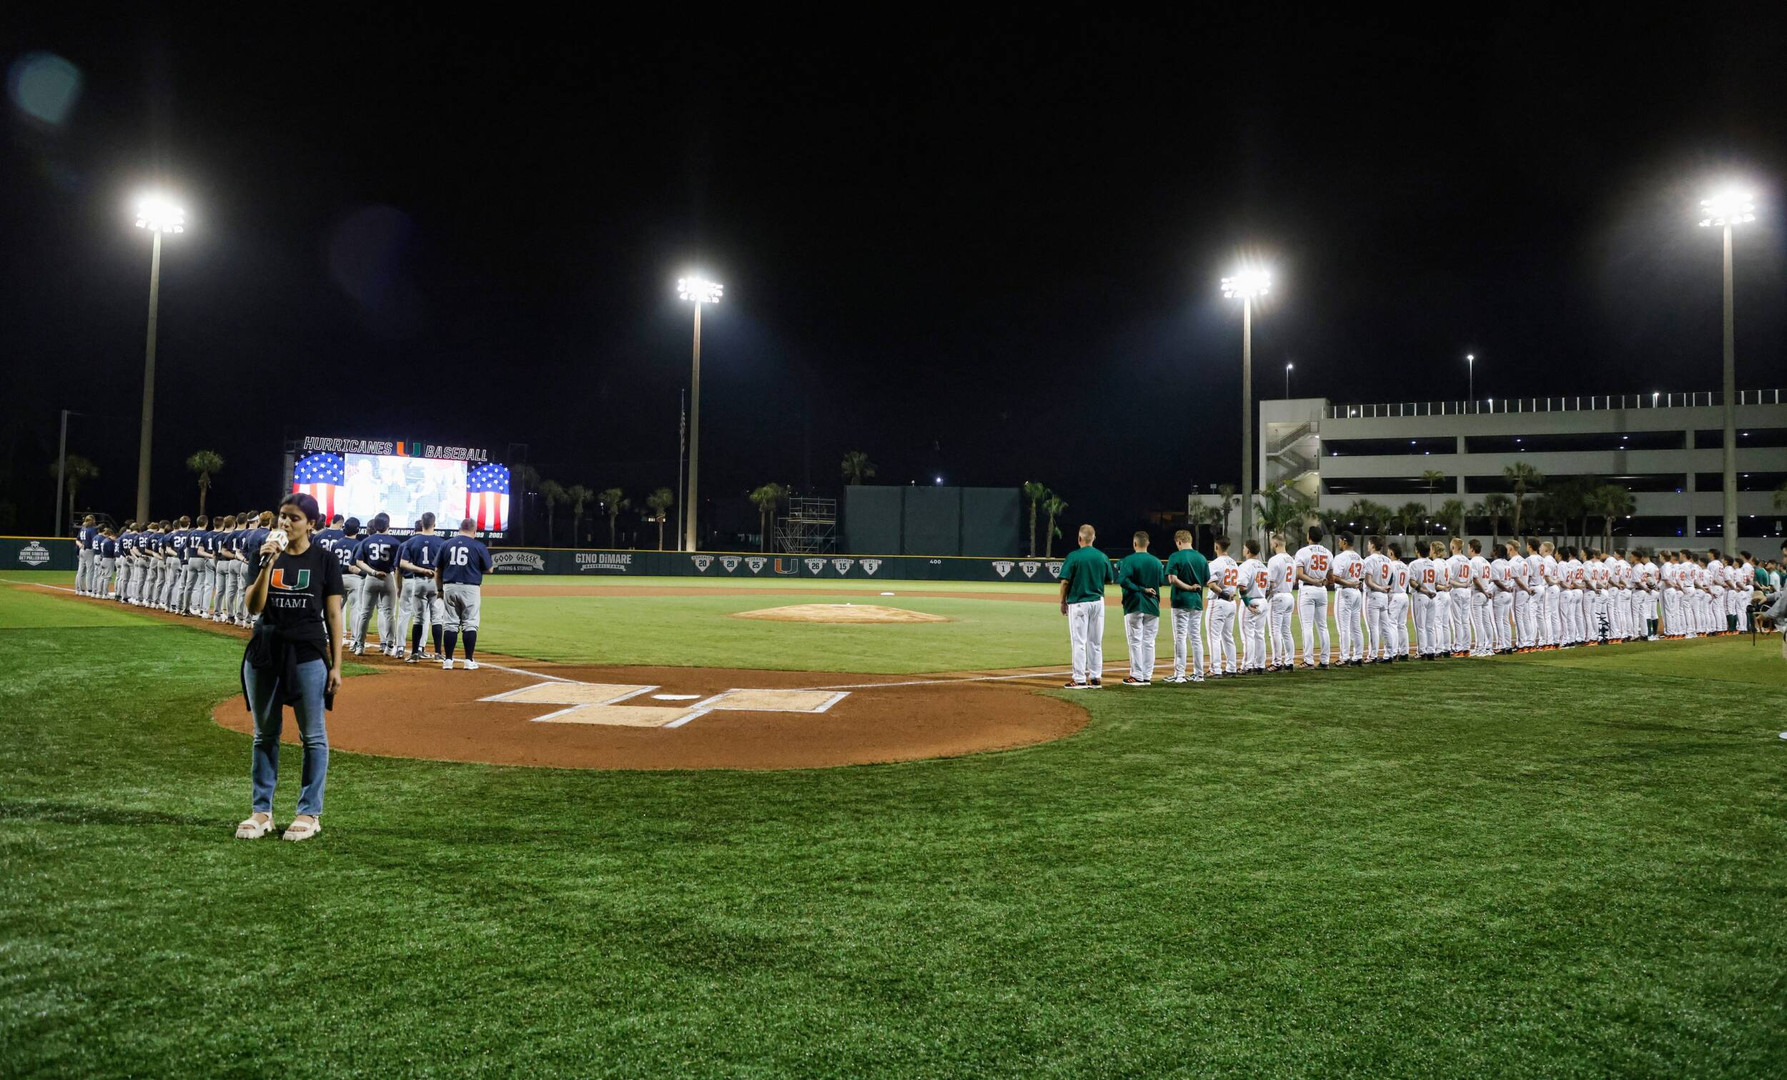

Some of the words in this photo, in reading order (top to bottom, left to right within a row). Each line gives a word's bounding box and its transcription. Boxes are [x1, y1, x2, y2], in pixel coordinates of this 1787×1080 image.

[303, 436, 393, 455] HURRICANES
[425, 445, 487, 461] BASEBALL
[190, 536, 201, 548] 17
[335, 548, 352, 566] 22
[368, 543, 390, 561] 35
[422, 546, 430, 565] 1
[449, 546, 469, 566] 16
[493, 554, 513, 563] GOOD
[516, 553, 539, 564] GREEK
[575, 553, 597, 564] GINO
[598, 553, 632, 564] DiMARE
[868, 563, 873, 571] 5
[1001, 565, 1006, 573] 1
[1052, 566, 1060, 574] 23
[1310, 554, 1328, 571] 35
[1348, 562, 1362, 579] 43
[1539, 563, 1545, 577] 8
[271, 568, 311, 590] U
[1223, 568, 1239, 587] 22
[1285, 565, 1293, 583] 2
[1381, 564, 1389, 580] 9
[1399, 571, 1406, 587] 0
[1423, 568, 1436, 584] 19
[1458, 564, 1470, 579] 10
[1481, 565, 1491, 579] 13
[1575, 568, 1584, 580] 28
[1255, 571, 1268, 589] 45
